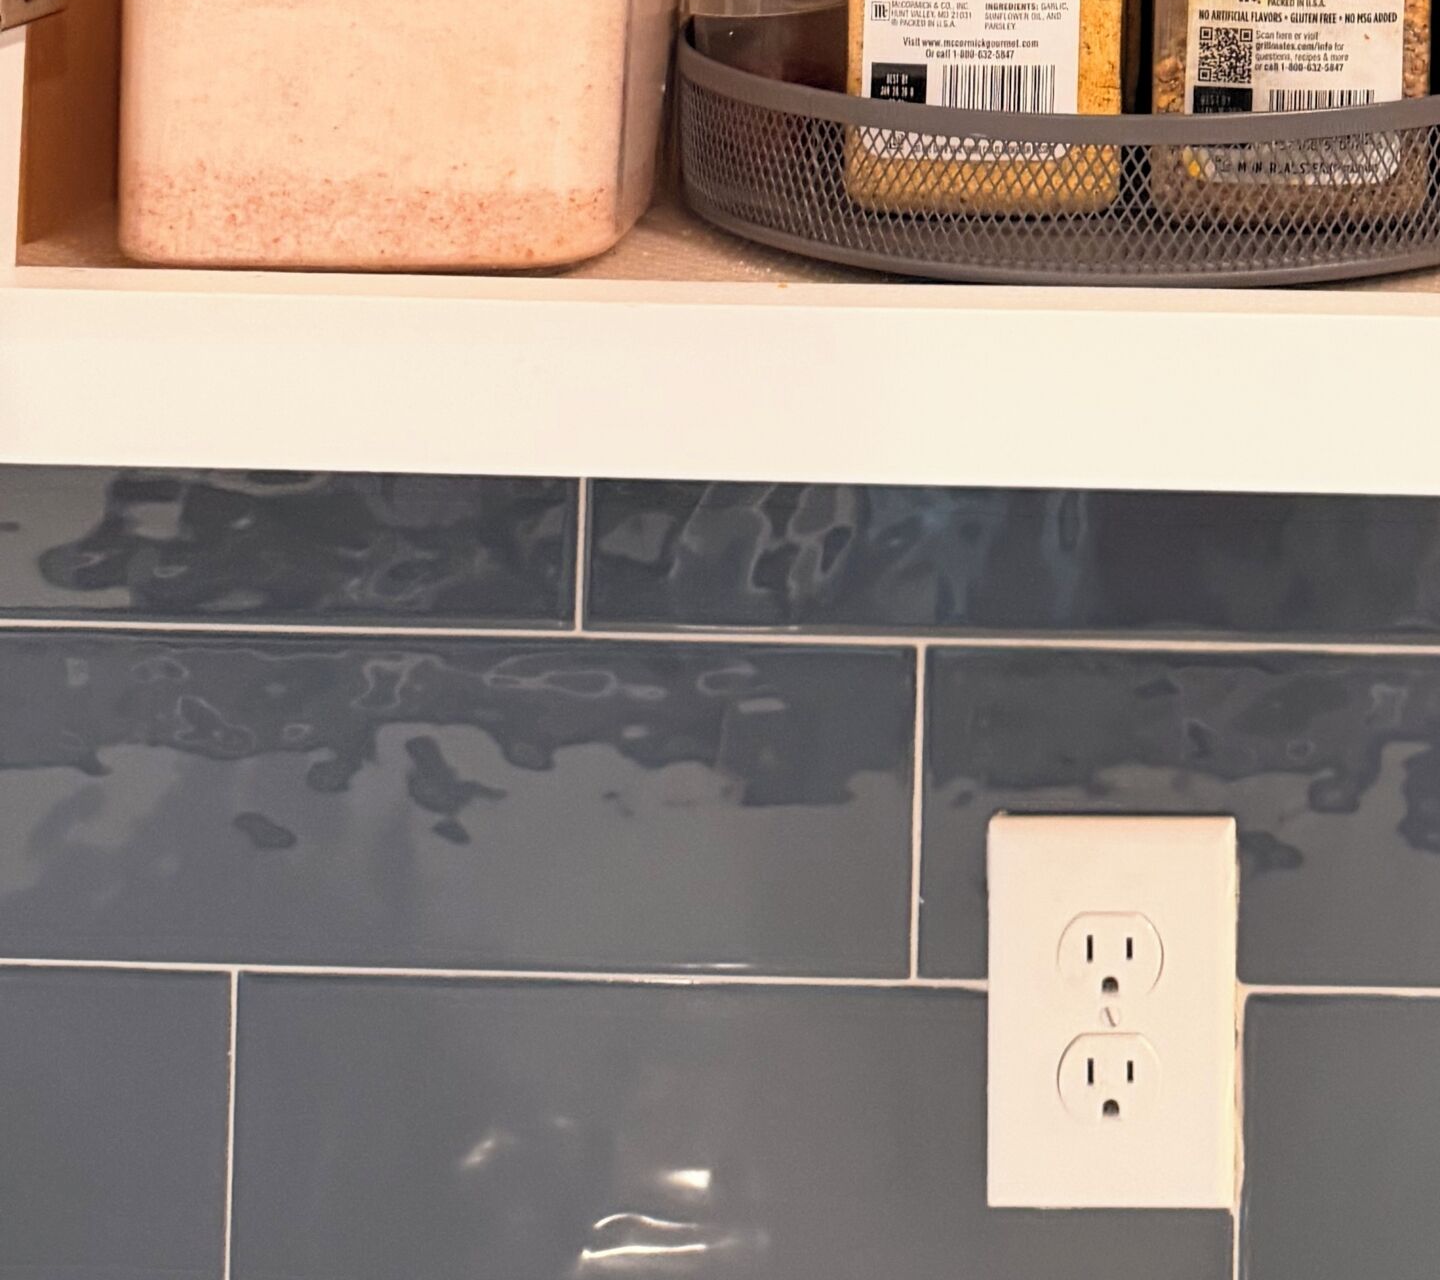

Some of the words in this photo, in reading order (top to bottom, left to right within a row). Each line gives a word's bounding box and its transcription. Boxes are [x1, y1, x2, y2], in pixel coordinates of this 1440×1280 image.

[1199, 10, 1209, 20] NO
[1212, 10, 1248, 21] ARTIFICIAL
[1251, 12, 1282, 23] FLAVORS
[1291, 12, 1318, 23] GLUTEN
[1320, 13, 1336, 23] FREE
[1345, 13, 1355, 24] NO
[1357, 13, 1372, 24] MSG
[1374, 12, 1397, 23] ADDED
